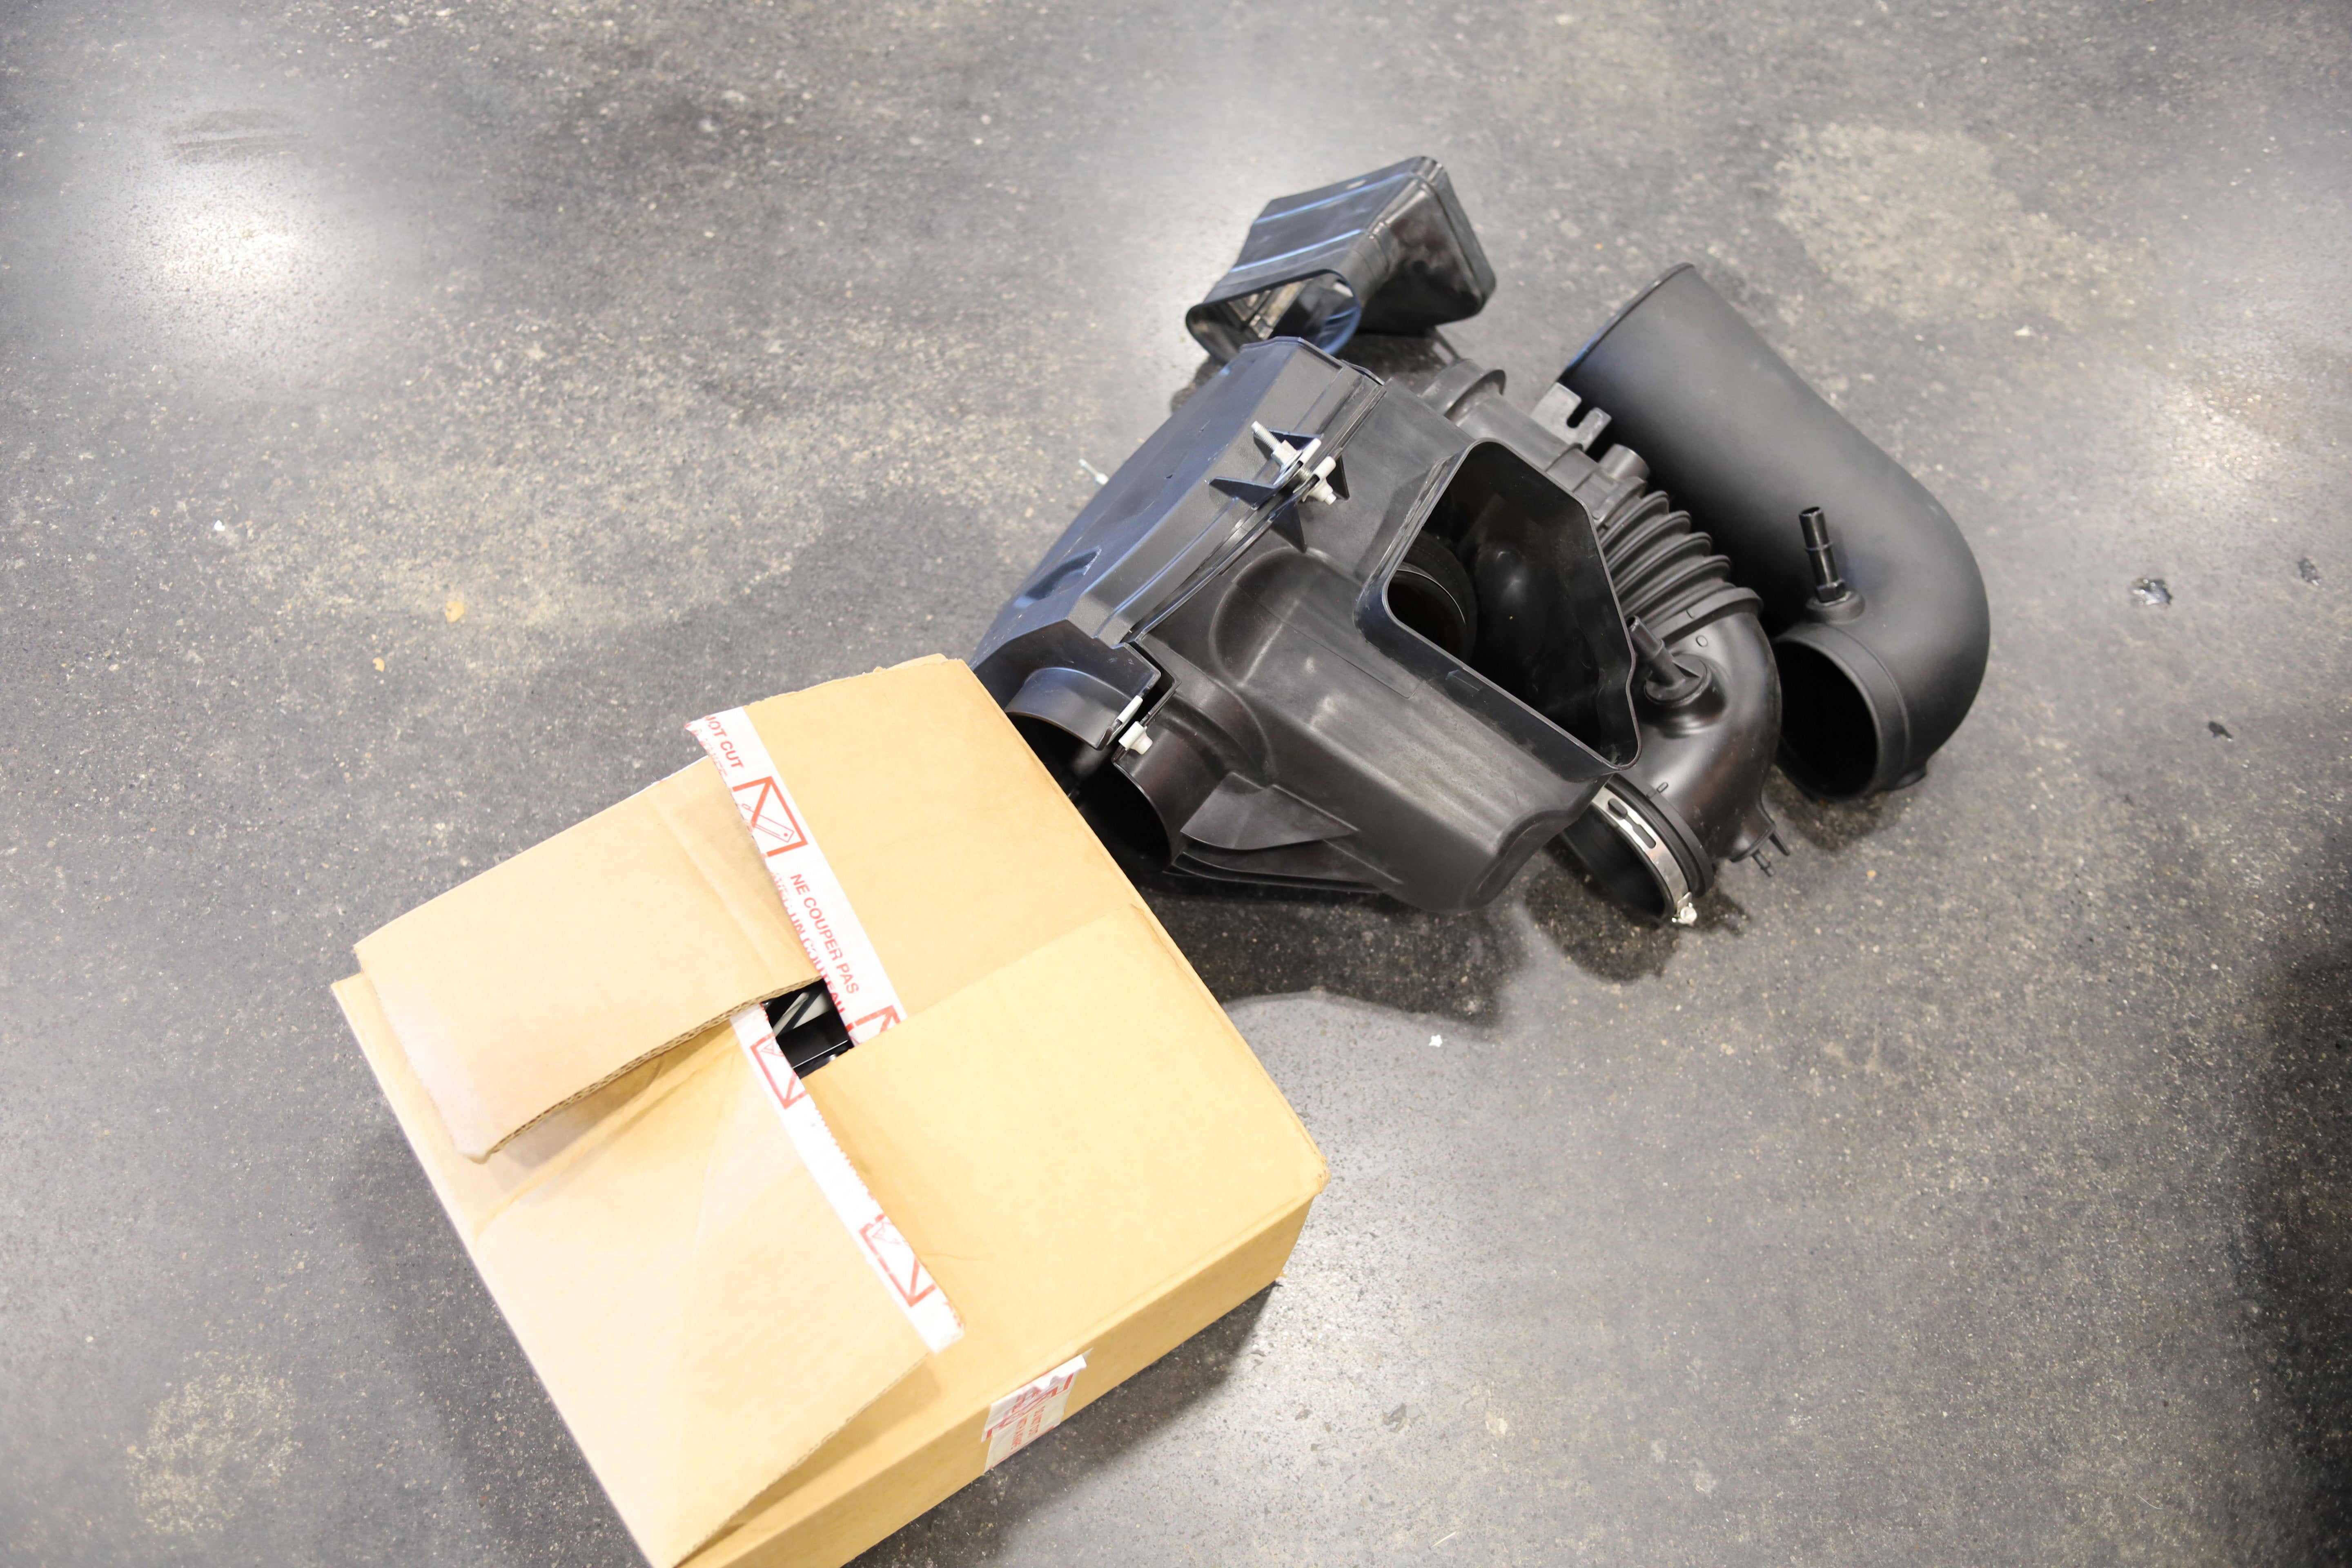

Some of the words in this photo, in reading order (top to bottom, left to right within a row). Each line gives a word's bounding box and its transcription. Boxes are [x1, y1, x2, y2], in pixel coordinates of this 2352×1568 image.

[720, 740, 744, 768] CUT
[790, 873, 811, 895] NE
[804, 897, 843, 961] COUPER
[836, 962, 859, 994] PAS
